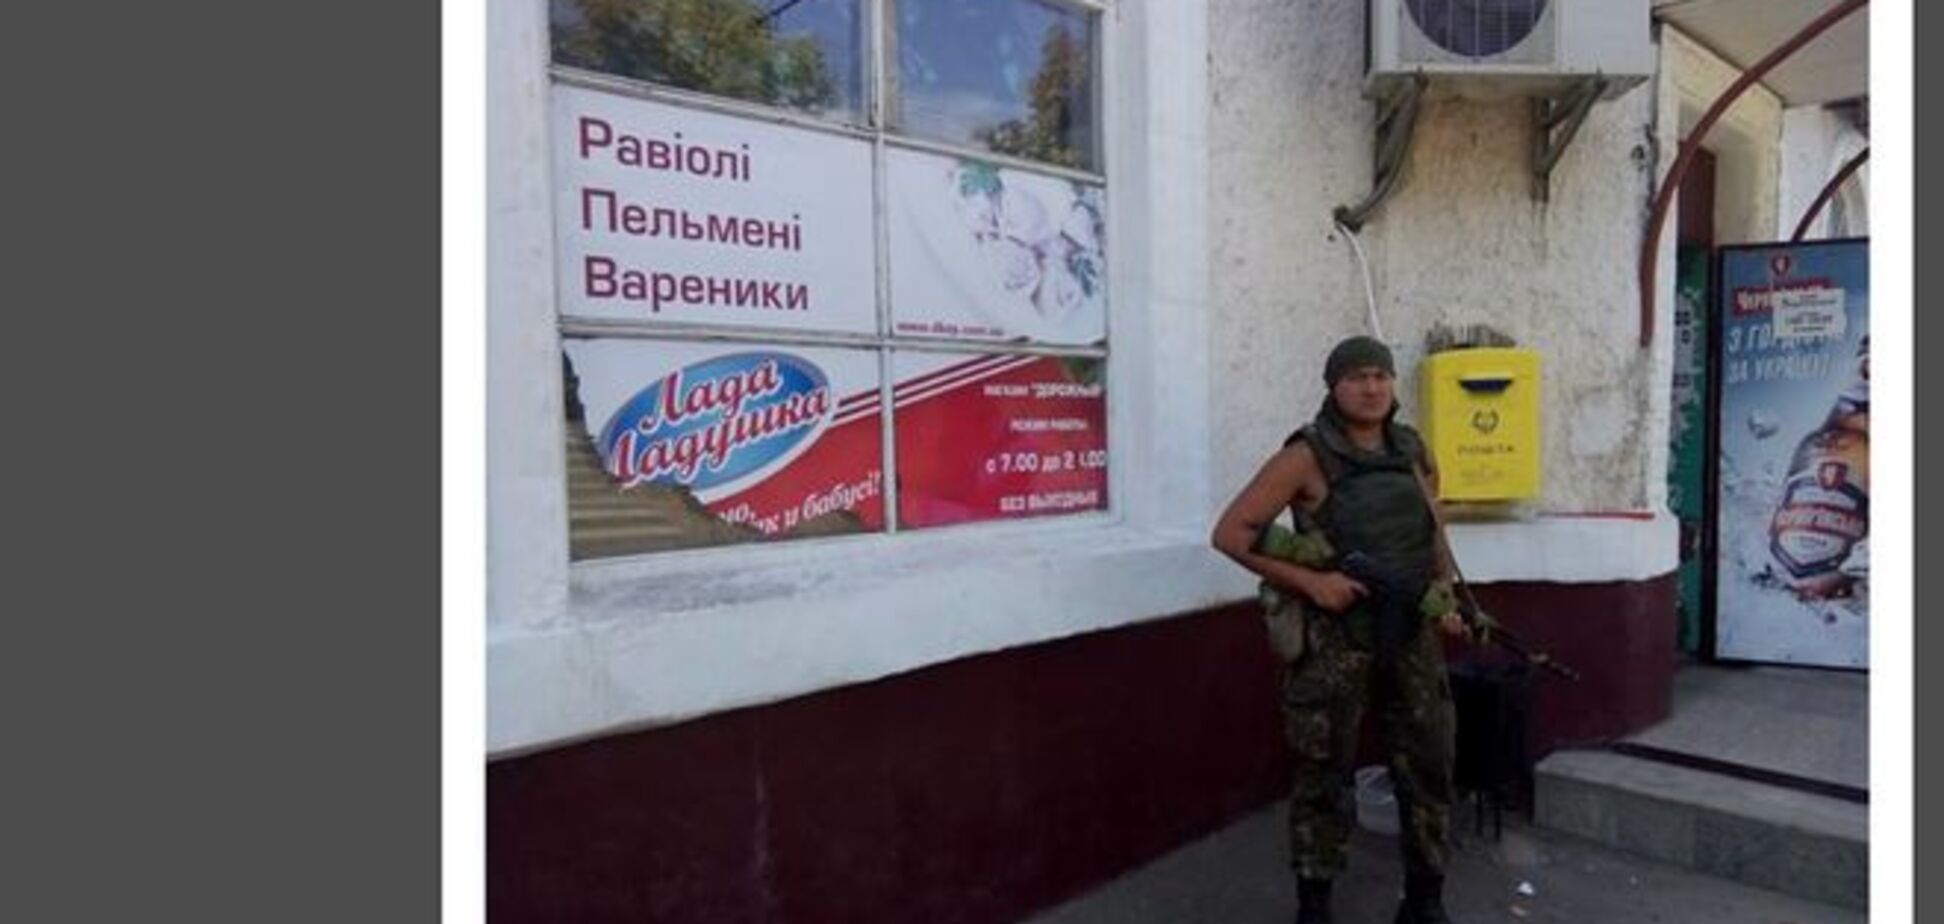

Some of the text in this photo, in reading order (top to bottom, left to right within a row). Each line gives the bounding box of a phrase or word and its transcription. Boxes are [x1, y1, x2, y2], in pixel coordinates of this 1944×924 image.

[578, 116, 751, 182] Равіолі
[581, 187, 803, 252] Пельмені
[584, 255, 809, 312] Вареники
[639, 358, 783, 431] Лада
[611, 385, 829, 485] Ладушка
[1000, 452, 1038, 472] 7.00
